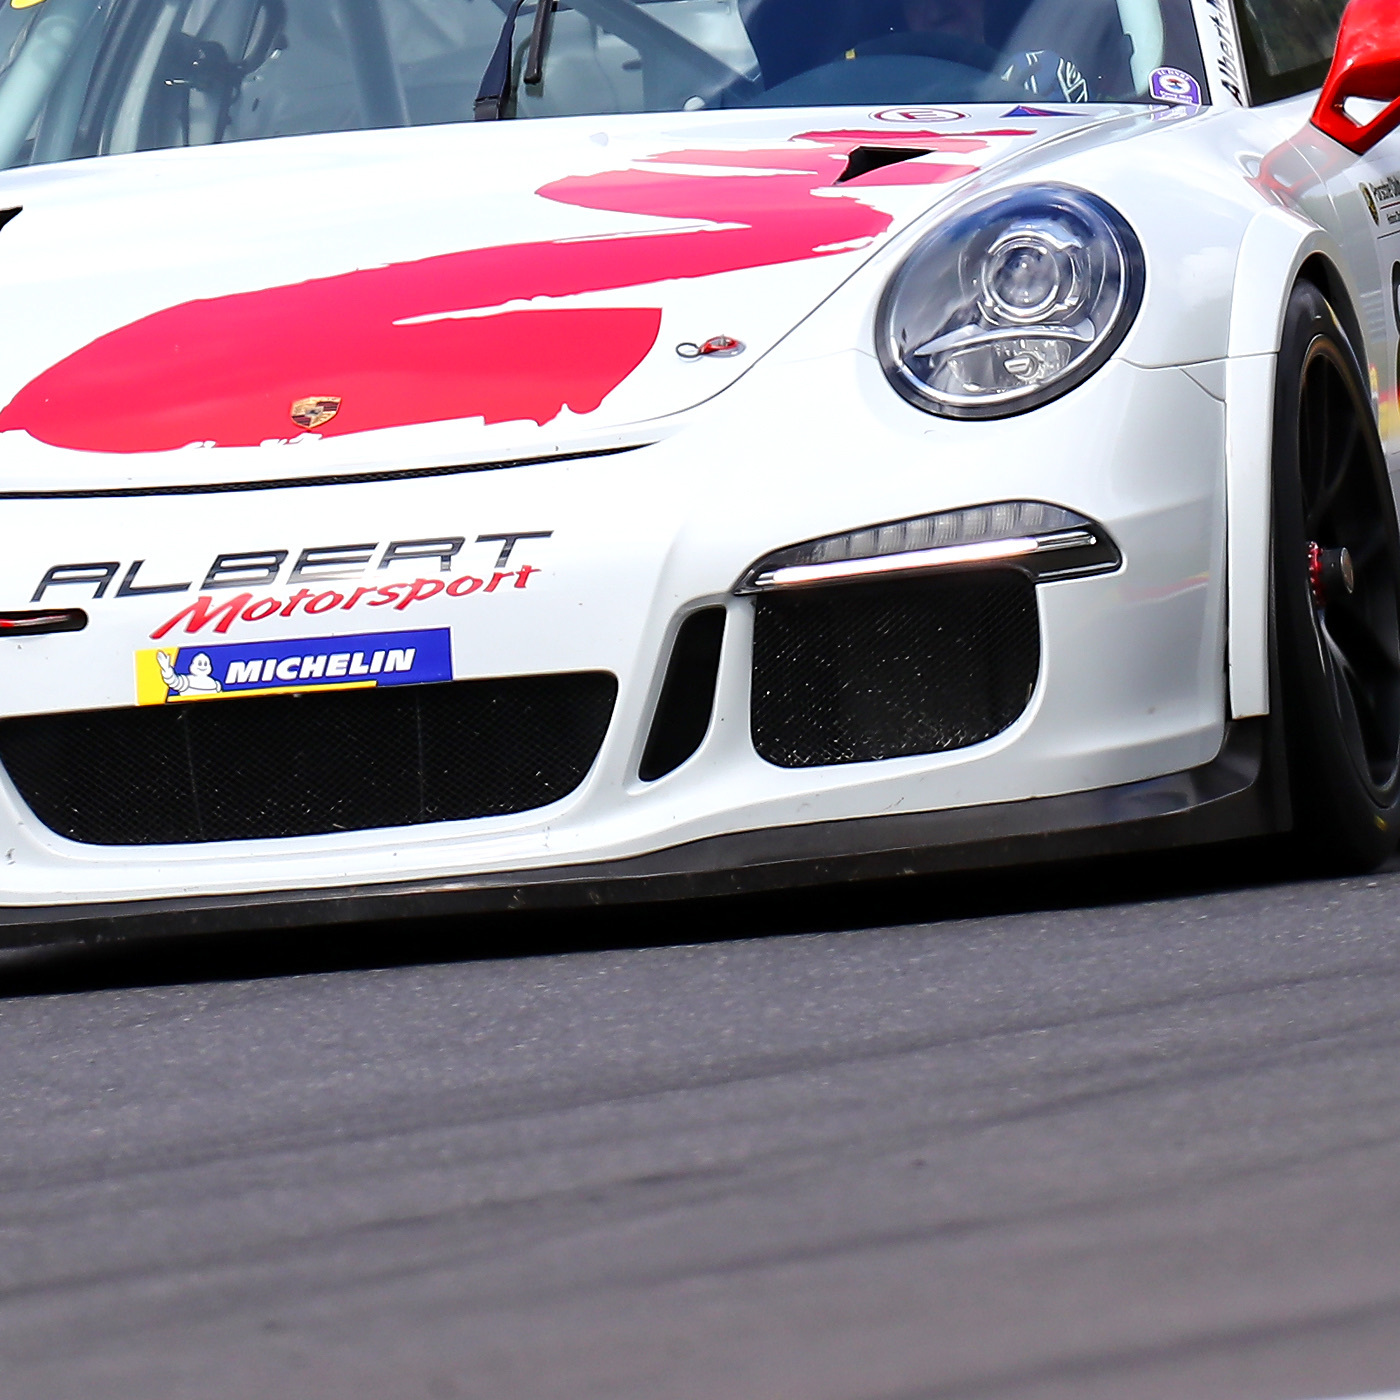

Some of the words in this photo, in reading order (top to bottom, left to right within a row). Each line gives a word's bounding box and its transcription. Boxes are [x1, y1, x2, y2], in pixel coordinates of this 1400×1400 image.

[32, 530, 554, 602] ALBERT
[149, 564, 542, 640] Motorsport
[224, 647, 416, 685] MICHELIN
